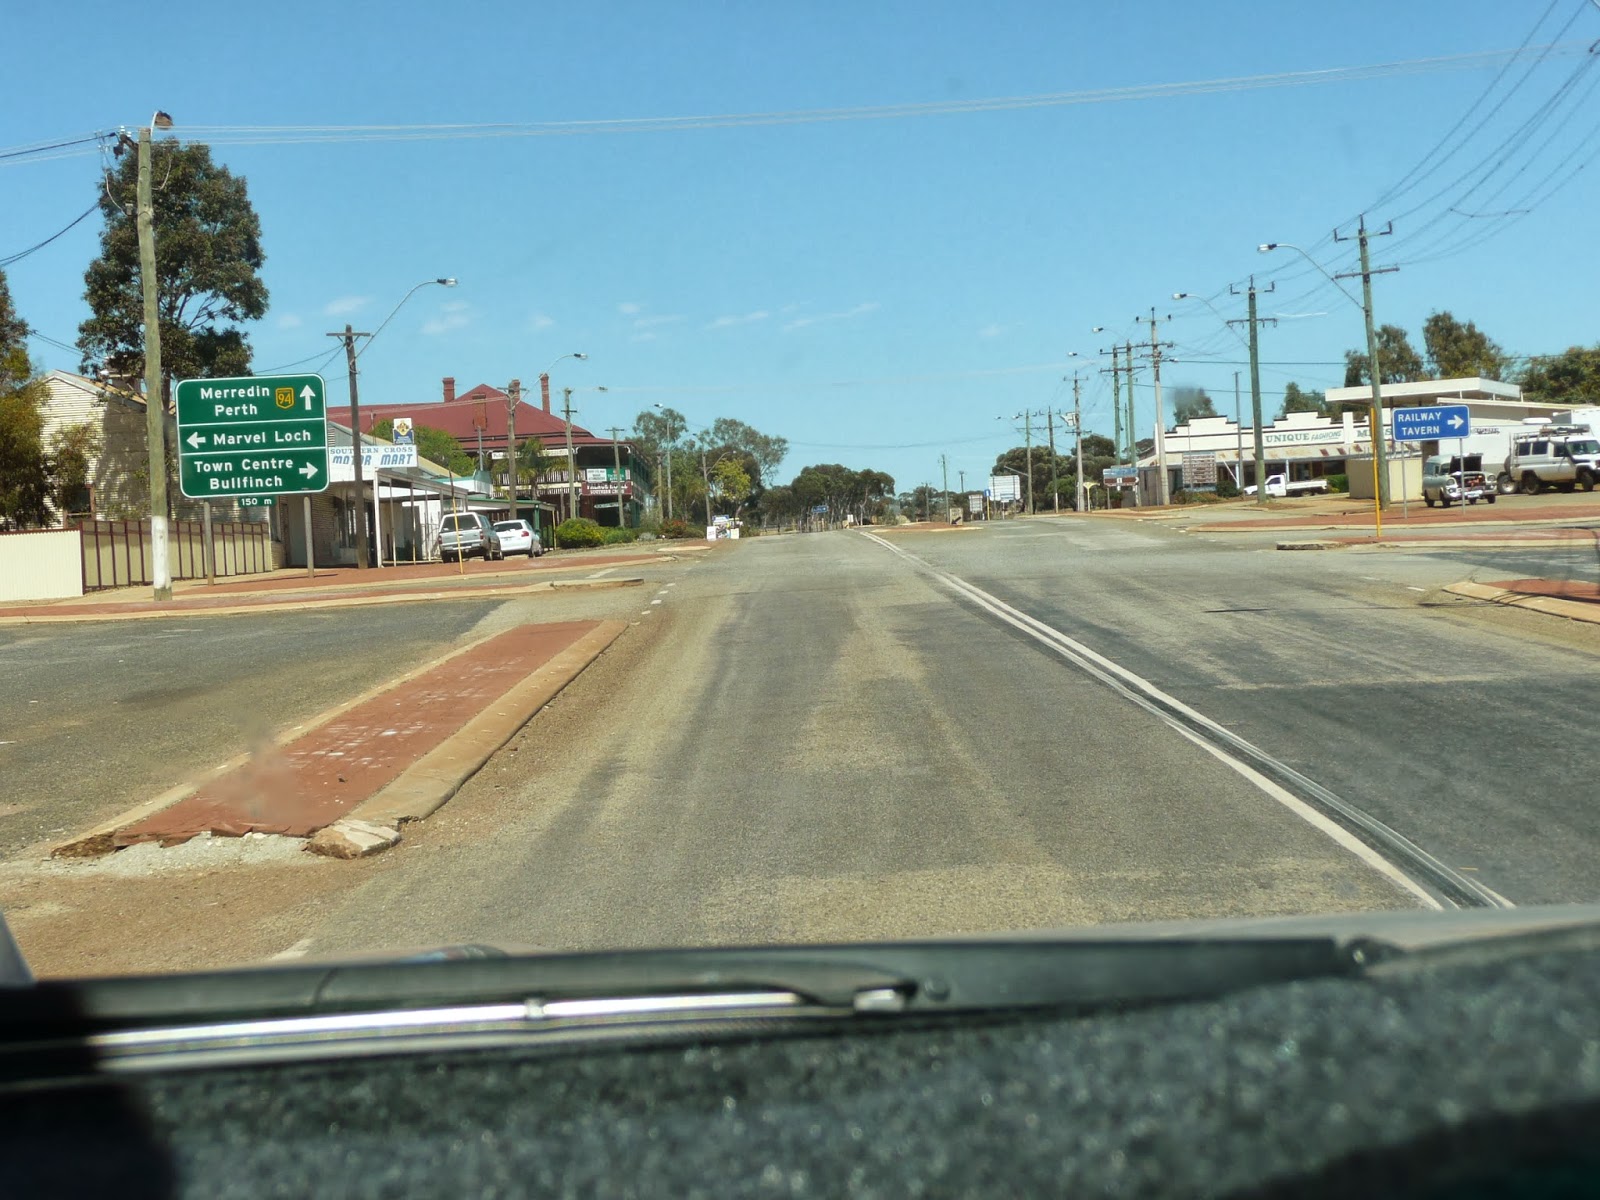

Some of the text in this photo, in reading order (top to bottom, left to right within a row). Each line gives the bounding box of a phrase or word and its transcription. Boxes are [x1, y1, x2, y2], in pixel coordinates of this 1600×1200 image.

[200, 386, 270, 400] Merredin
[278, 393, 292, 404] 94
[214, 404, 258, 416] Perth
[1397, 411, 1442, 422] RAILWAY
[1401, 425, 1440, 436] TAVERN
[213, 430, 311, 445] Marvel Loch
[1265, 430, 1342, 443] UNIQUE FASHIONS
[330, 447, 379, 455] SOUTERN
[380, 454, 413, 465] MART
[194, 458, 294, 473] Town Centre
[209, 476, 283, 490] Bullfinch
[241, 498, 258, 506] 150
